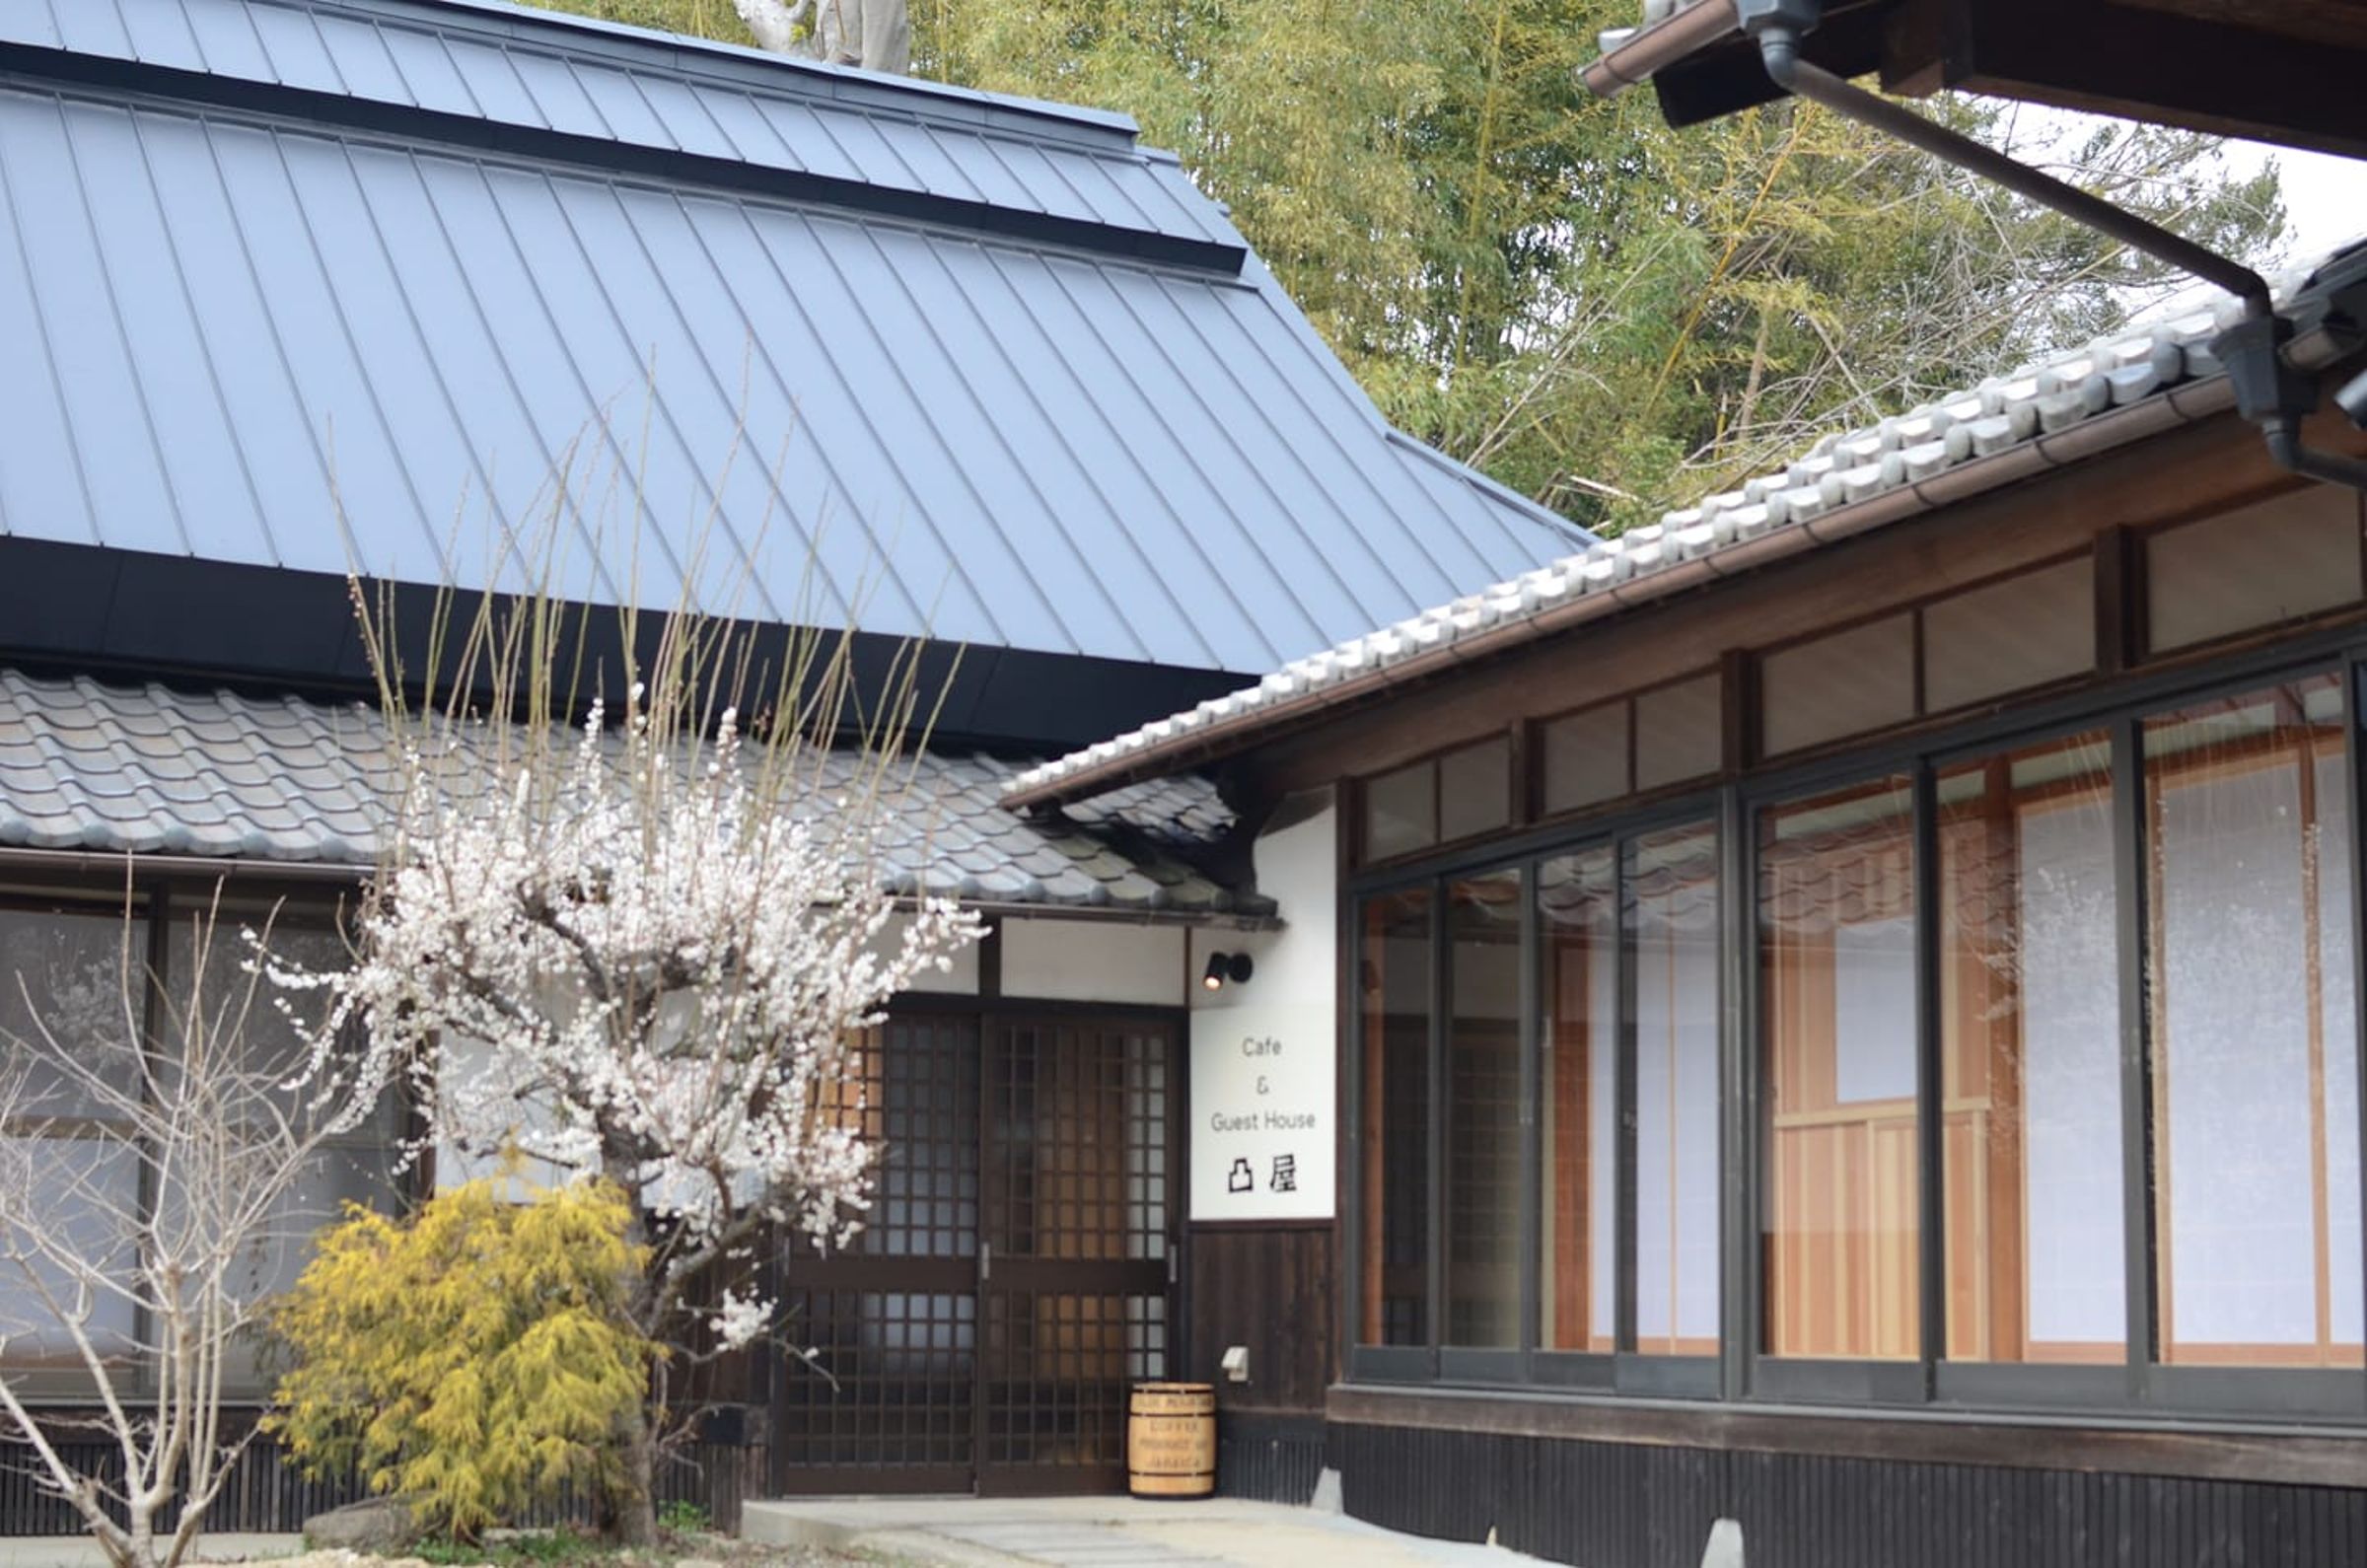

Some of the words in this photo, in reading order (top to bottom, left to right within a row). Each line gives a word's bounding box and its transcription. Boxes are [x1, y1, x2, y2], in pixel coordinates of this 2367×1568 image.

[1242, 1037, 1282, 1056] Cafe
[1256, 1076, 1269, 1095] &
[1211, 1111, 1258, 1131] Guest
[1264, 1111, 1316, 1130] House
